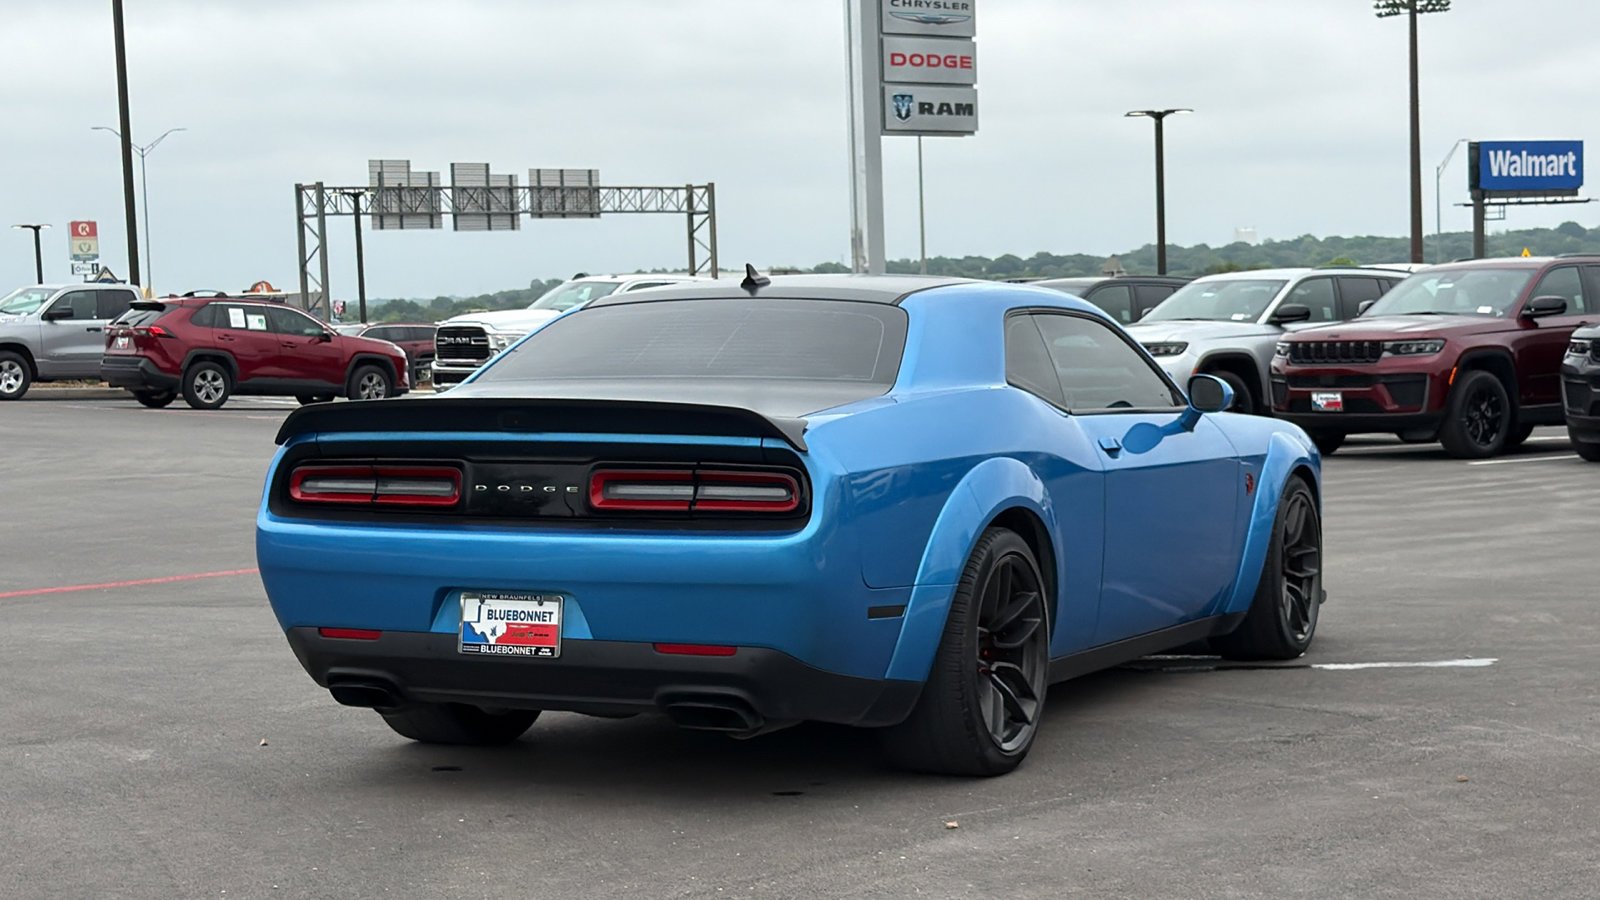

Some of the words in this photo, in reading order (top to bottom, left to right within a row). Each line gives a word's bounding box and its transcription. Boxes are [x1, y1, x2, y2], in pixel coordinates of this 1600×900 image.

[890, 0, 969, 10] CHRYSLER
[890, 53, 972, 68] DODGE
[918, 102, 974, 116] RAM
[1488, 150, 1576, 176] Walmart
[487, 609, 554, 622] BLUEBONNET
[481, 645, 536, 655] BLUEBONNET
